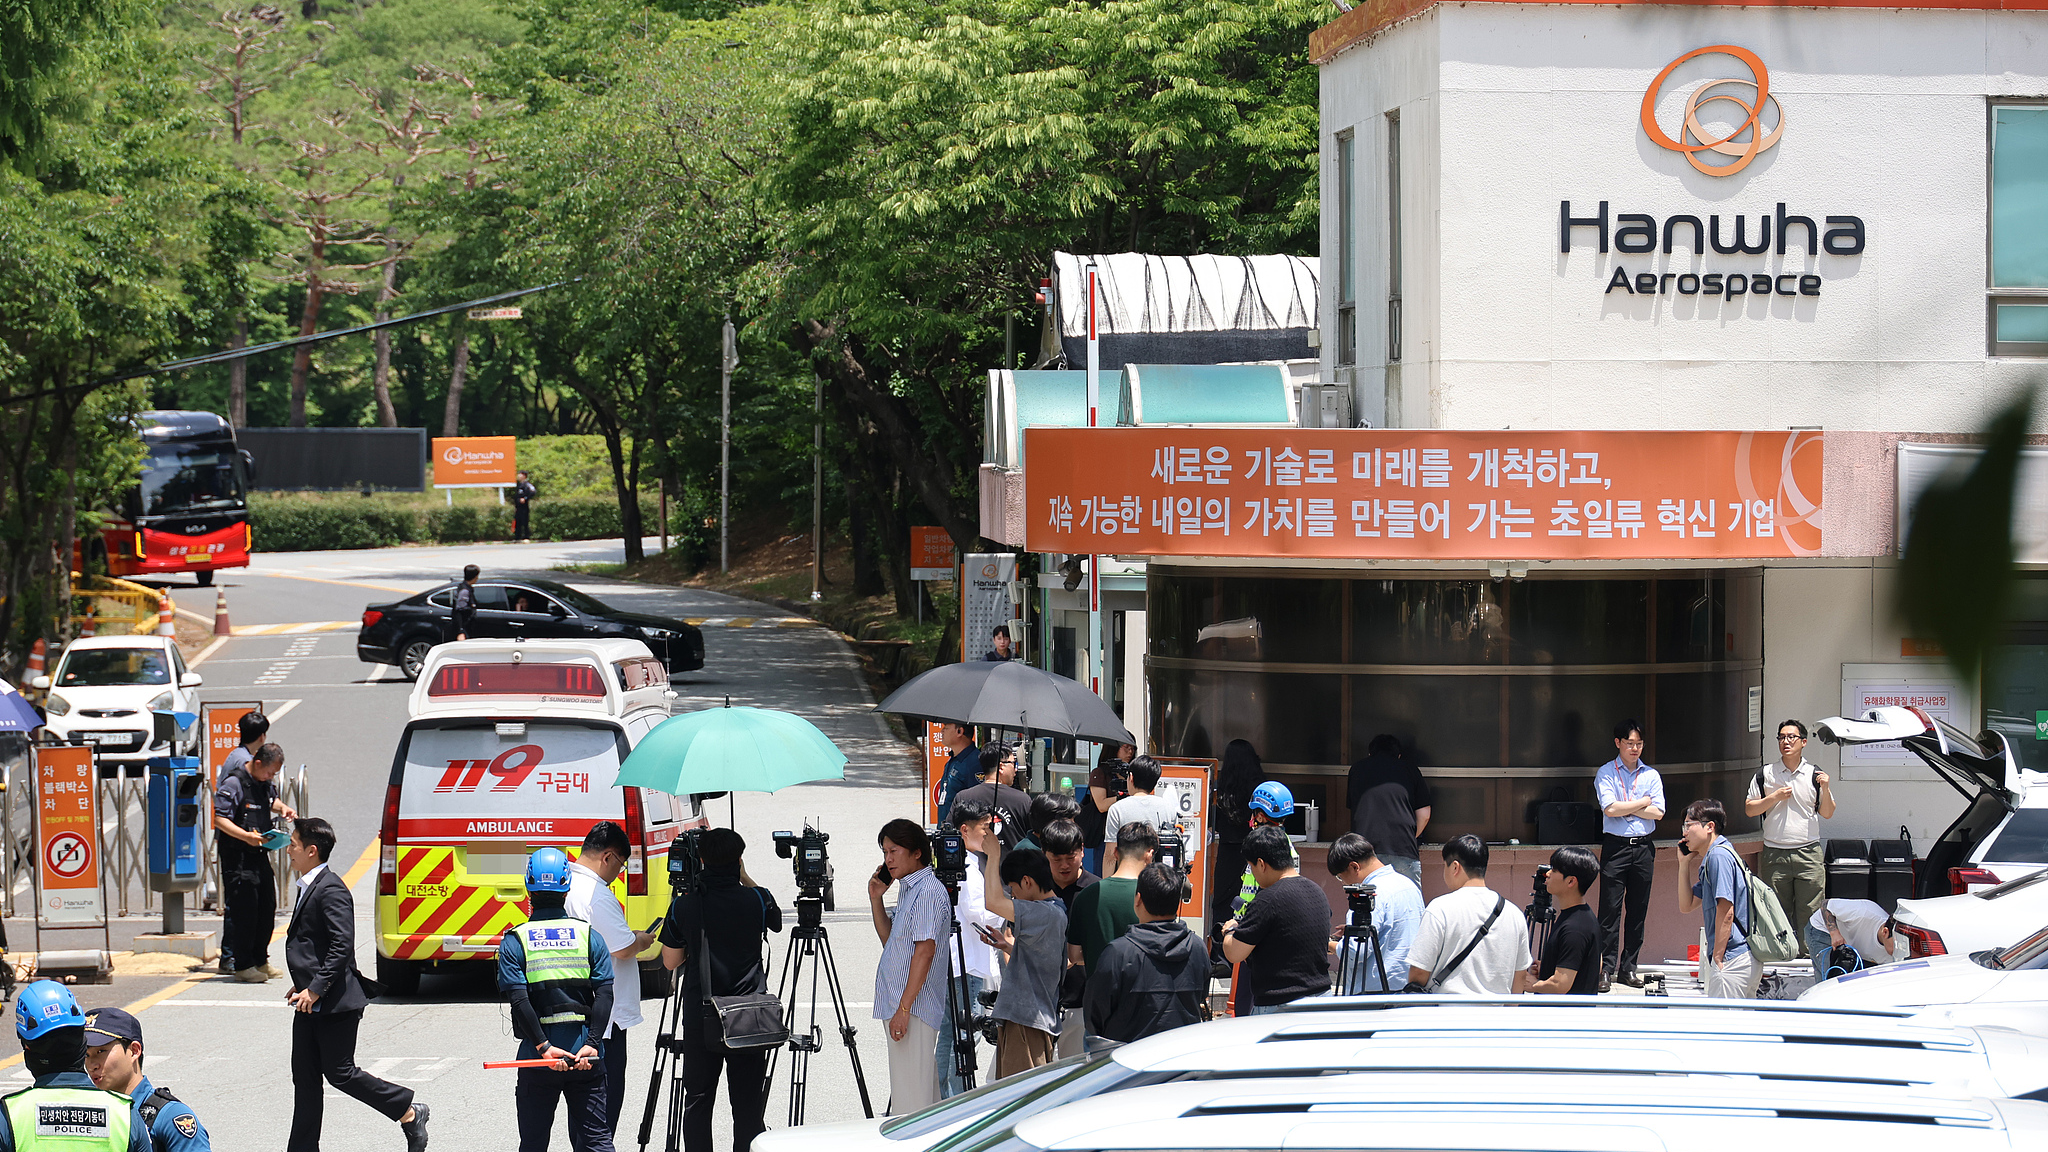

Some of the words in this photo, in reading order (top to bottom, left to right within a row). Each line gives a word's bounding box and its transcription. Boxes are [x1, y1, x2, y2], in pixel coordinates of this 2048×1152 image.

[1561, 201, 1865, 255] Hanwha
[1605, 266, 1822, 302] Aerospace
[1150, 446, 1233, 485] 새로운
[1244, 446, 1338, 486] 기술로
[1352, 447, 1453, 488] 미래를
[1467, 447, 1612, 491] 개척하고,
[1048, 495, 1073, 534] 지속
[1080, 496, 1143, 535] 가능한
[1152, 497, 1230, 536] 내일의
[1243, 498, 1338, 537] 가치를
[1352, 499, 1450, 539] 만들어
[1467, 500, 1535, 539] 가는
[1548, 500, 1646, 539] 초일류
[1657, 499, 1716, 539] 혁신
[1728, 500, 1775, 539] 기업
[1863, 696, 1908, 706] 유해화학물질
[1910, 696, 1946, 706] 취급사업장
[433, 744, 544, 793] 119
[536, 773, 589, 793] 구급대
[43, 780, 89, 795] 블랙박스
[1180, 792, 1192, 812] 6
[466, 821, 554, 833] AMBULANCE
[406, 884, 450, 898] 대전소방
[533, 940, 573, 948] POLICE
[40, 1109, 70, 1124] 민생치안
[70, 1110, 105, 1124] 전담기동대
[54, 1126, 92, 1134] POLICE
